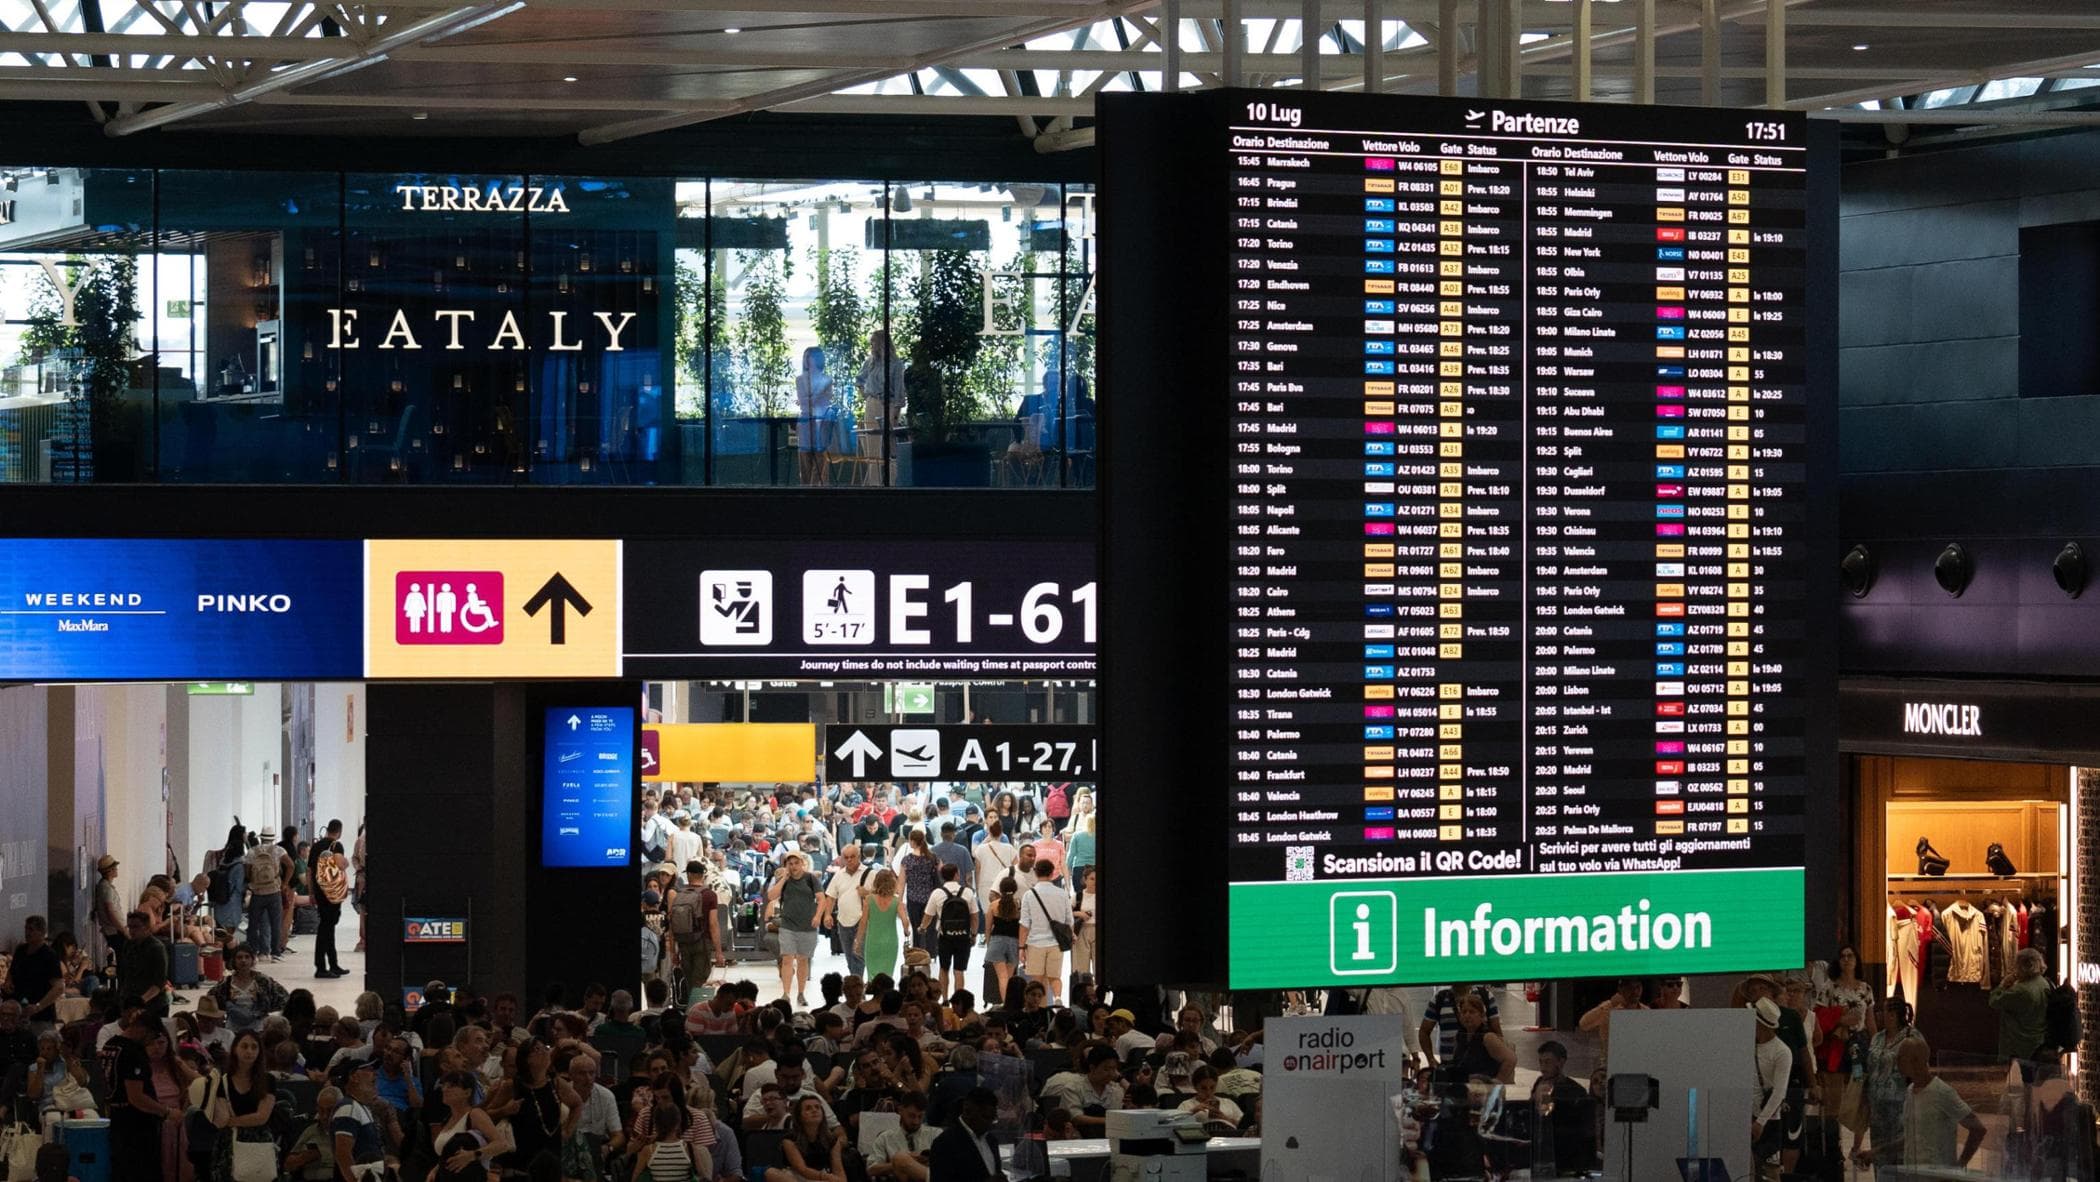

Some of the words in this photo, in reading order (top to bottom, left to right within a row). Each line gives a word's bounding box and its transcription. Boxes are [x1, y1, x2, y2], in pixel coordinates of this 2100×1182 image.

[1246, 103, 1266, 120] 10
[1271, 104, 1302, 126] Lug
[1491, 110, 1580, 136] Partenze
[1745, 122, 1785, 141] 17:51
[1232, 136, 1264, 148] Orario
[1267, 137, 1330, 150] Destinazione
[1362, 140, 1398, 152] Vettore
[1398, 142, 1421, 153] Volo
[1440, 143, 1463, 154] Gate
[1467, 144, 1498, 156] Status
[1531, 147, 1562, 158] Orario
[1564, 148, 1623, 160] Destinazione
[1653, 150, 1687, 162] Vettore
[1688, 152, 1709, 163] Volo
[1728, 153, 1750, 165] Gate
[1753, 154, 1783, 166] Status
[396, 185, 570, 213] TERRAZZA
[326, 309, 637, 351] EATALY
[25, 593, 143, 606] WEEKEND
[198, 594, 291, 613] PINKO
[57, 618, 109, 632] MaxMara
[800, 660, 840, 672] Journey
[841, 660, 870, 670] times
[871, 660, 885, 670] do
[886, 660, 904, 670] not
[905, 660, 942, 670] include
[943, 660, 980, 672] waiting
[981, 660, 1009, 670] times
[1010, 661, 1021, 670] at
[1022, 661, 1065, 672] passport
[1904, 702, 1982, 736] MONCLER
[1539, 842, 1579, 854] Scrivici
[1580, 844, 1600, 856] per
[1601, 844, 1631, 853] avere
[1632, 840, 1657, 852] tutti
[1658, 839, 1673, 854] gli
[1674, 837, 1751, 853] aggiornamenti
[1323, 853, 1416, 874] Scansiona
[1420, 850, 1432, 870] il
[1435, 850, 1464, 871] QR
[1468, 848, 1522, 870] Code!
[1539, 861, 1556, 873] sul
[1557, 861, 1577, 872] tuo
[1578, 859, 1602, 872] volo
[1603, 859, 1621, 871] via
[1622, 857, 1681, 872] WhatsApp!
[1425, 899, 1711, 957] Information
[1299, 1027, 1354, 1048] radio
